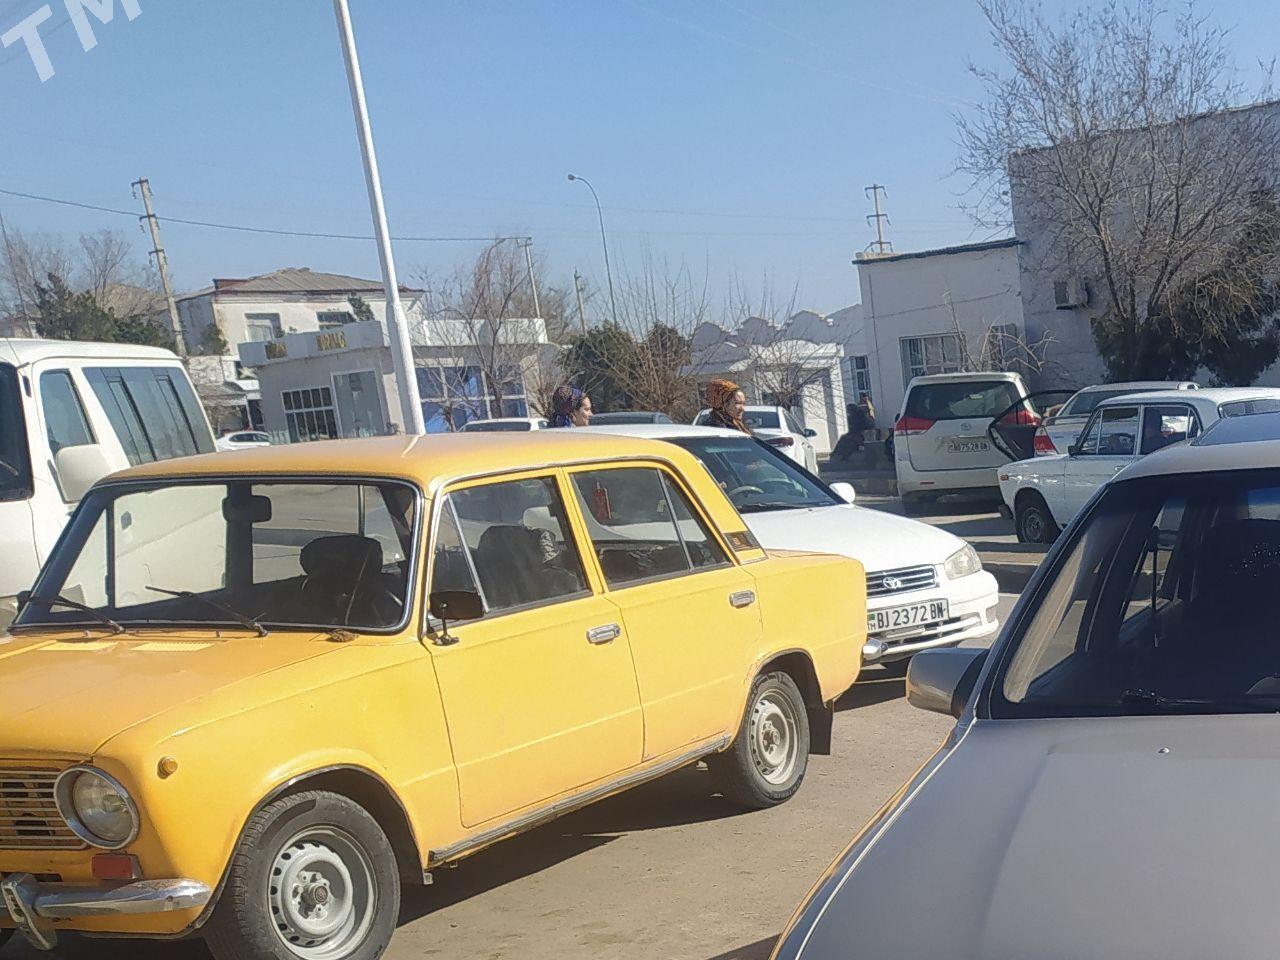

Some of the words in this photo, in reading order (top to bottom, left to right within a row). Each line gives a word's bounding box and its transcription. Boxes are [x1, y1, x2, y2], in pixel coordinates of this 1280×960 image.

[877, 611, 890, 629] BJ
[892, 605, 928, 627] 2372
[930, 602, 944, 620] BN
